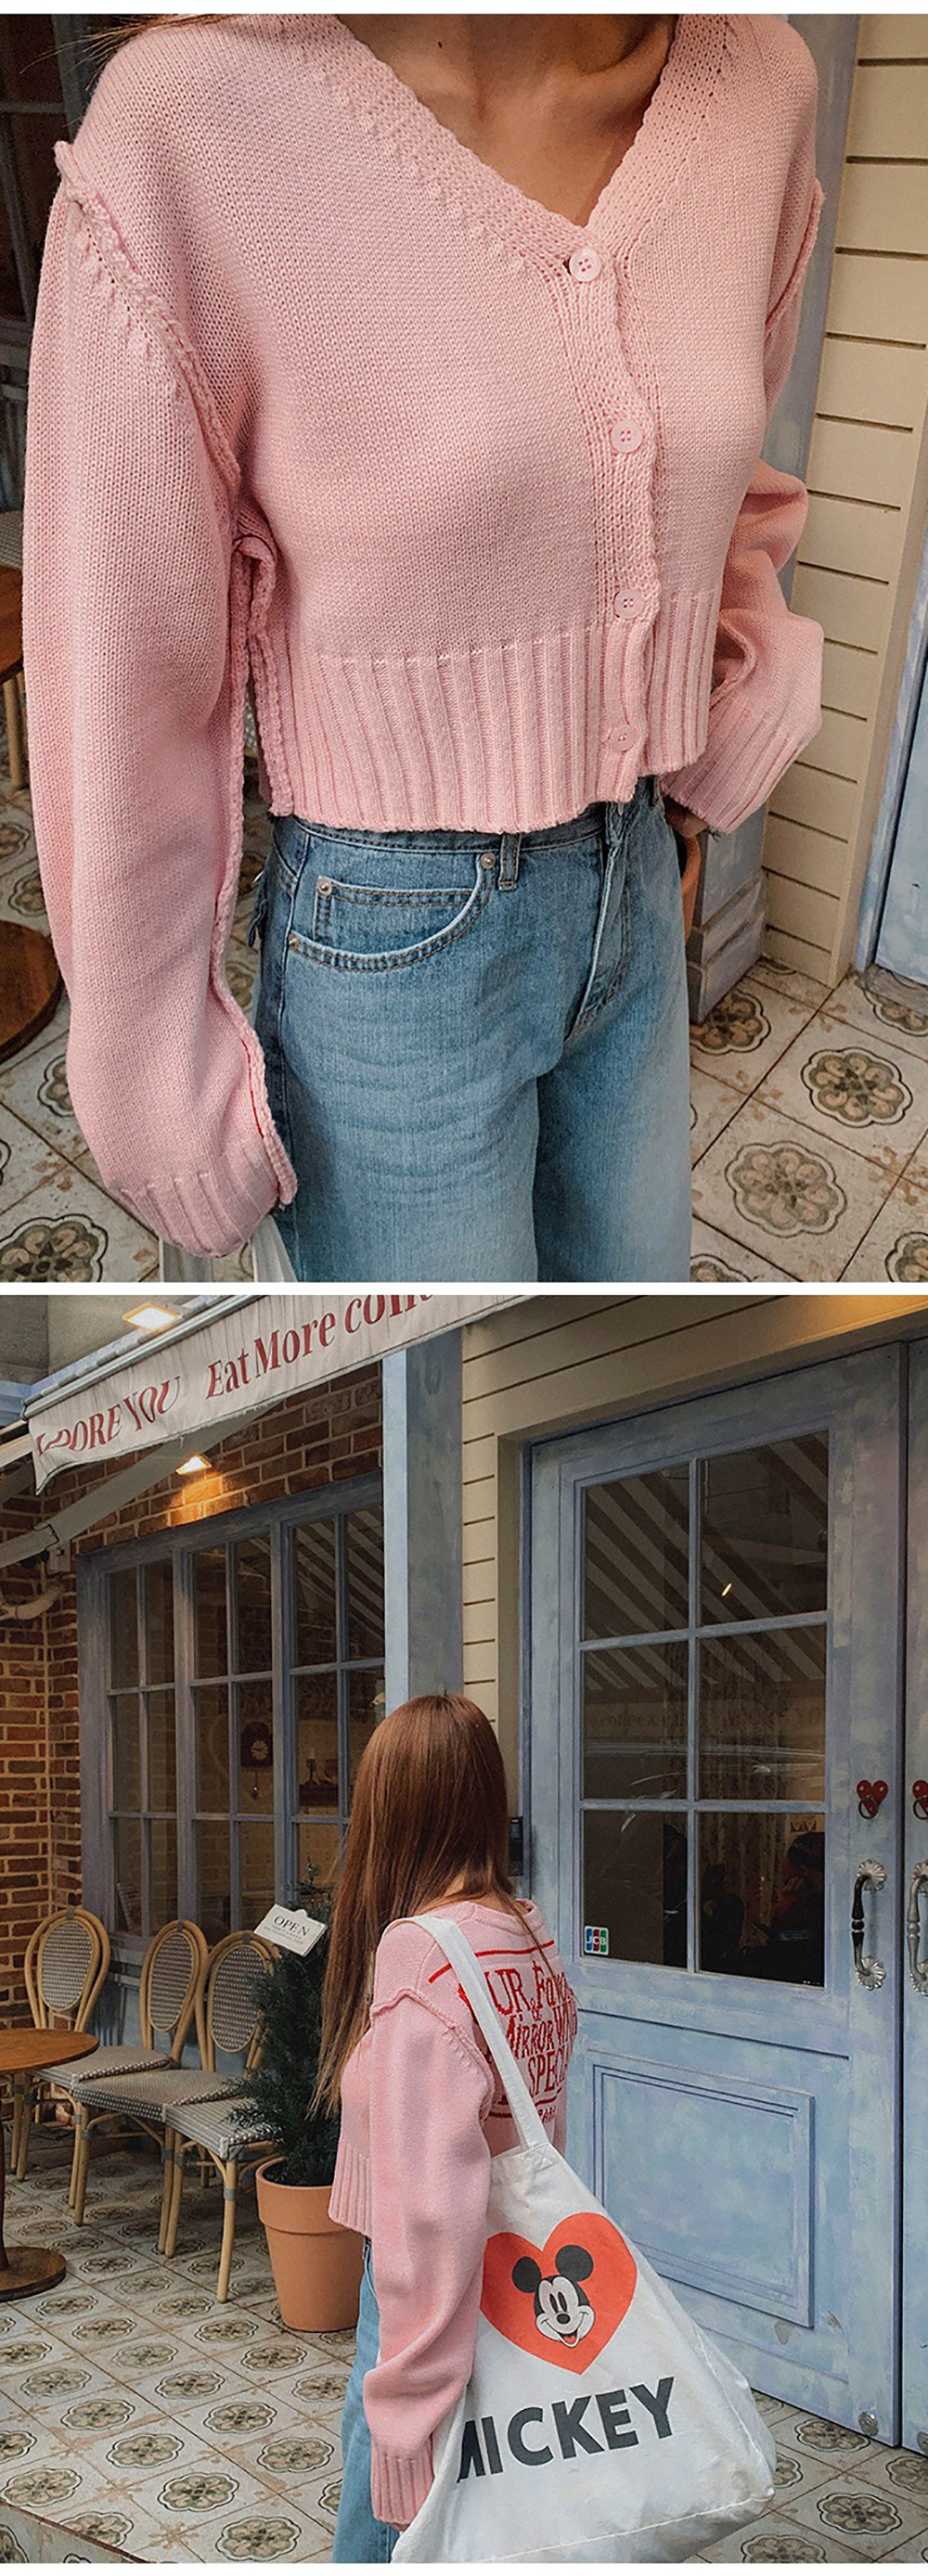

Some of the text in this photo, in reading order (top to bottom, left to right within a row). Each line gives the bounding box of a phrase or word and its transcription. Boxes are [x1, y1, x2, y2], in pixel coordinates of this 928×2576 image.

[205, 1347, 251, 1400] Eat
[253, 1312, 336, 1378] More
[122, 1376, 181, 1432] YOU
[274, 1916, 310, 1937] OPEN
[456, 2377, 675, 2484] MICKEY
